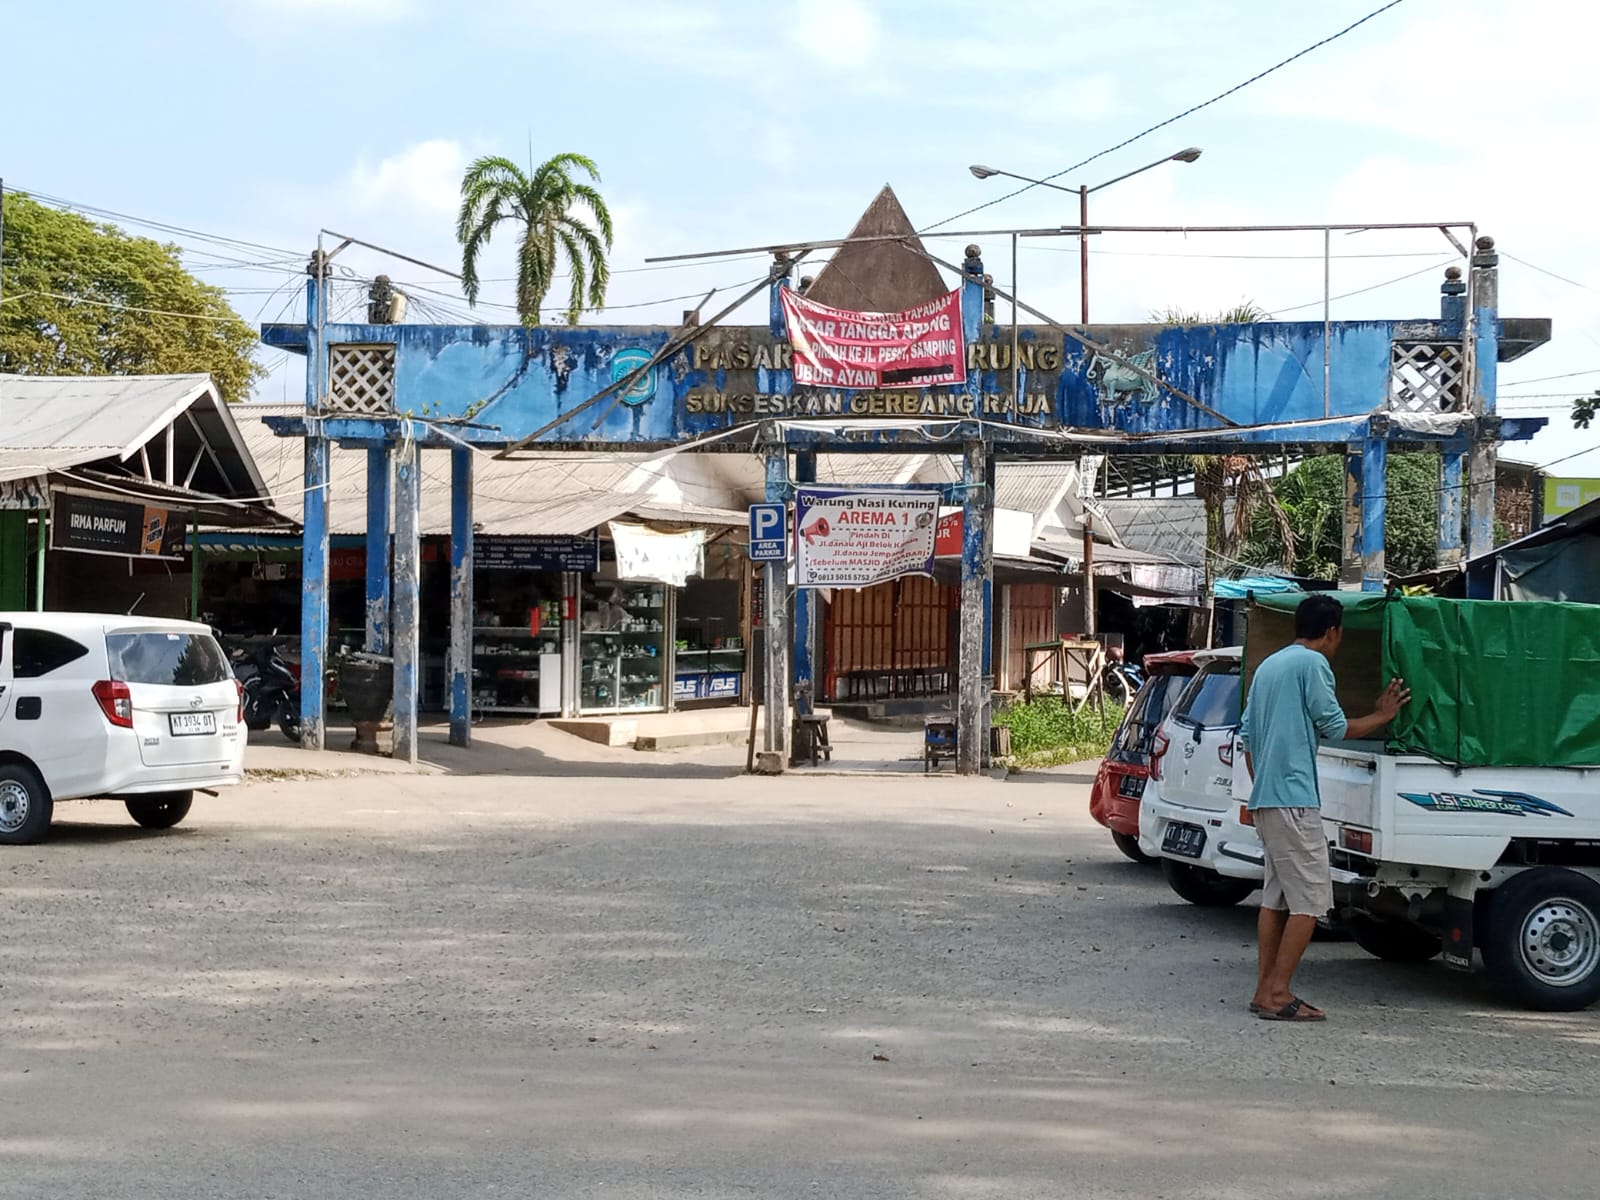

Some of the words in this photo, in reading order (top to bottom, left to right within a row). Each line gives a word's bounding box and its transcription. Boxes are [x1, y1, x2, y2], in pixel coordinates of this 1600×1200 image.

[793, 318, 836, 337] ASAR
[840, 321, 898, 340] TANGGA
[693, 343, 792, 370] PASAR
[968, 344, 1059, 371] RUNG
[849, 346, 862, 362] KE
[911, 339, 956, 359] SAMPING
[837, 368, 878, 386] AYAM
[686, 392, 842, 414] SUKSESKAN
[851, 393, 974, 414] GERBANG
[983, 393, 1051, 414] RAJA
[802, 496, 854, 509] Warung
[857, 498, 885, 508] Nasi
[888, 499, 936, 510] Kuning
[70, 513, 92, 530] IRMA
[93, 517, 127, 534] PARFUM
[755, 508, 779, 539] P
[838, 511, 897, 526] AREMA
[902, 512, 909, 526] 1
[850, 531, 880, 539] Pindah
[755, 549, 781, 557] PARKIR
[758, 542, 778, 550] AREA
[849, 559, 881, 567] MASJID
[674, 680, 698, 693] SUS
[709, 677, 737, 691] ASUS
[1460, 797, 1498, 810] SUPER
